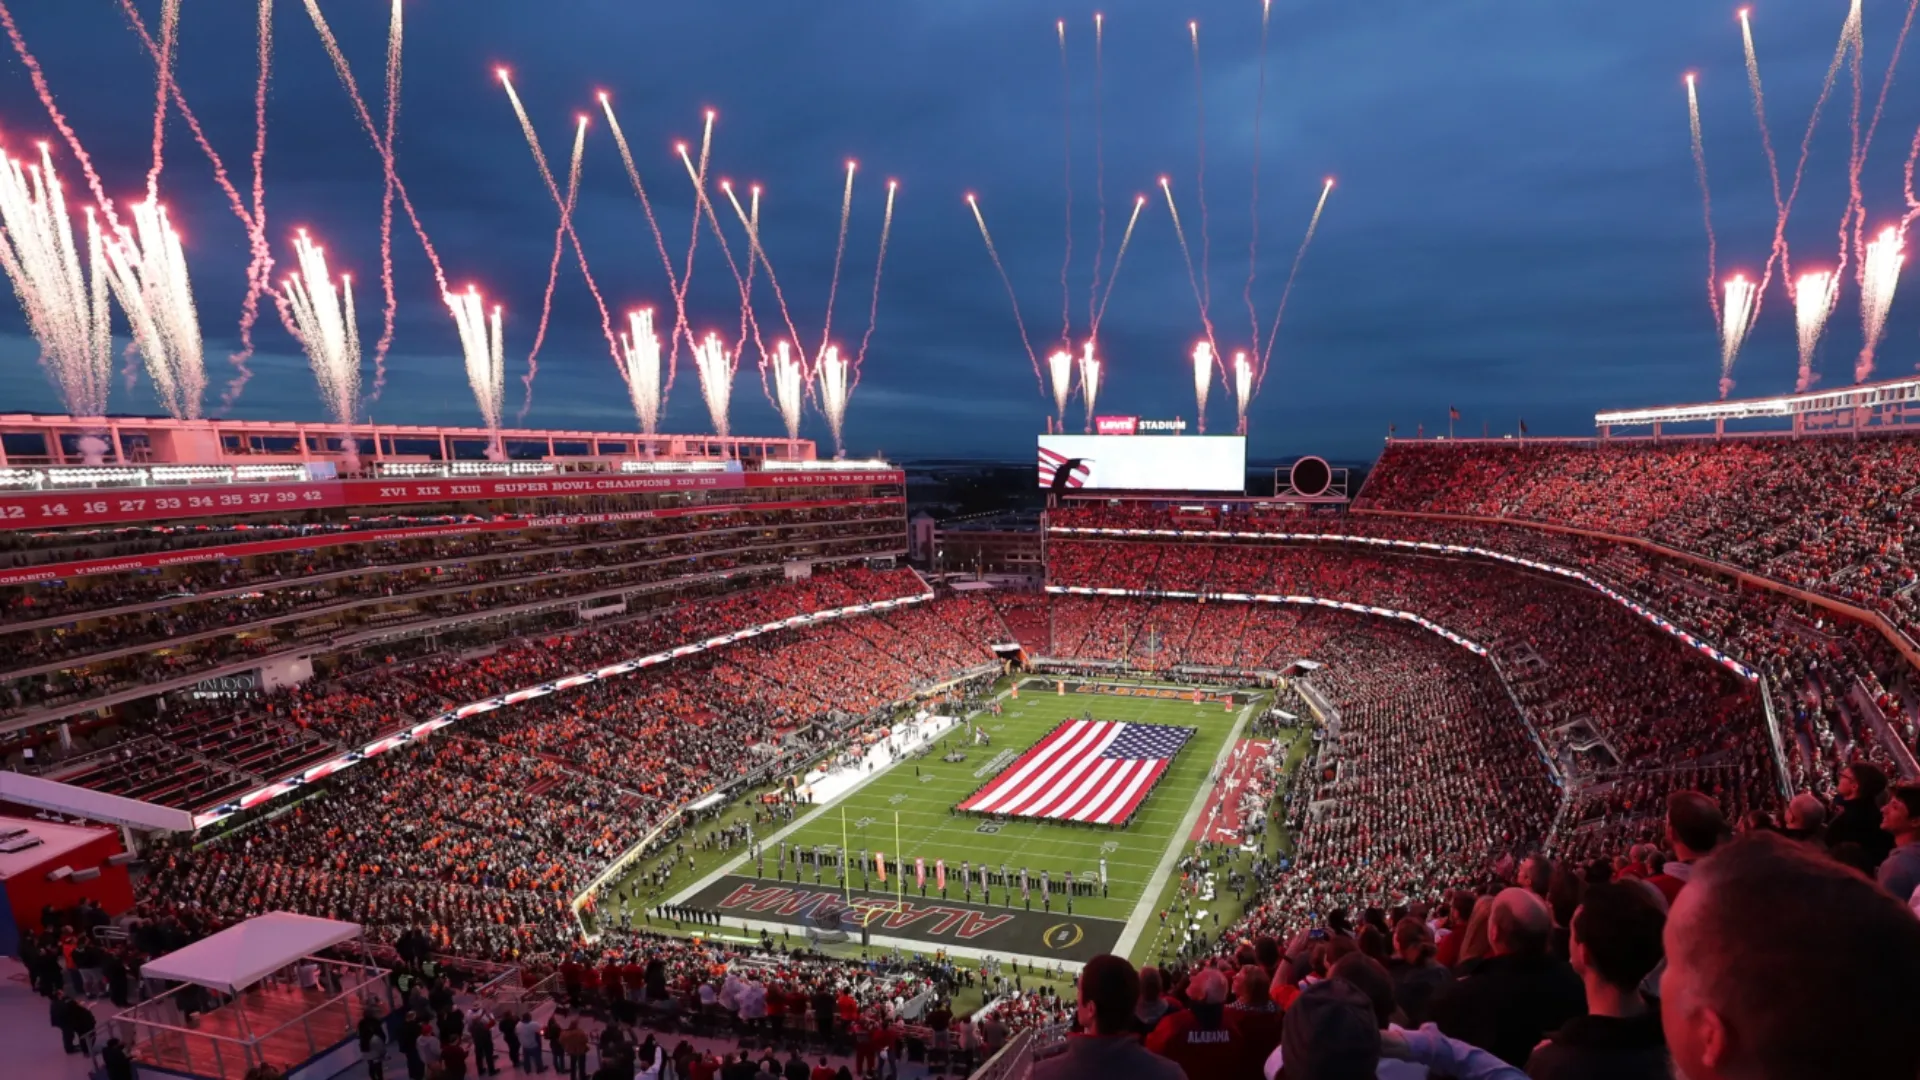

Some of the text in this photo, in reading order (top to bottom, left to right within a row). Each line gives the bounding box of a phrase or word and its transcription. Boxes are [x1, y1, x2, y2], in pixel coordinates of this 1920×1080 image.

[1139, 421, 1186, 430] STADIUM
[380, 487, 407, 497] XVI
[416, 486, 441, 496] XIX
[451, 485, 481, 494] XXIII
[494, 483, 548, 492] SUPER
[552, 481, 593, 491] BOWL
[597, 478, 671, 489] CHAMPIONS
[40, 503, 68, 516] 14
[83, 501, 107, 513] 16
[119, 499, 145, 511] 27
[155, 498, 181, 509] 33
[189, 496, 213, 507] 34
[220, 494, 243, 505] 35
[250, 493, 269, 504] 37
[277, 491, 297, 502] 39
[303, 490, 322, 500] 42
[528, 511, 656, 527] HOME OF THE FAITHFUL
[0, 571, 56, 583] ORABITO
[87, 562, 142, 573] MORABITO
[717, 883, 1015, 939] ALABAMA
[1187, 1030, 1230, 1043] ALABAMA
